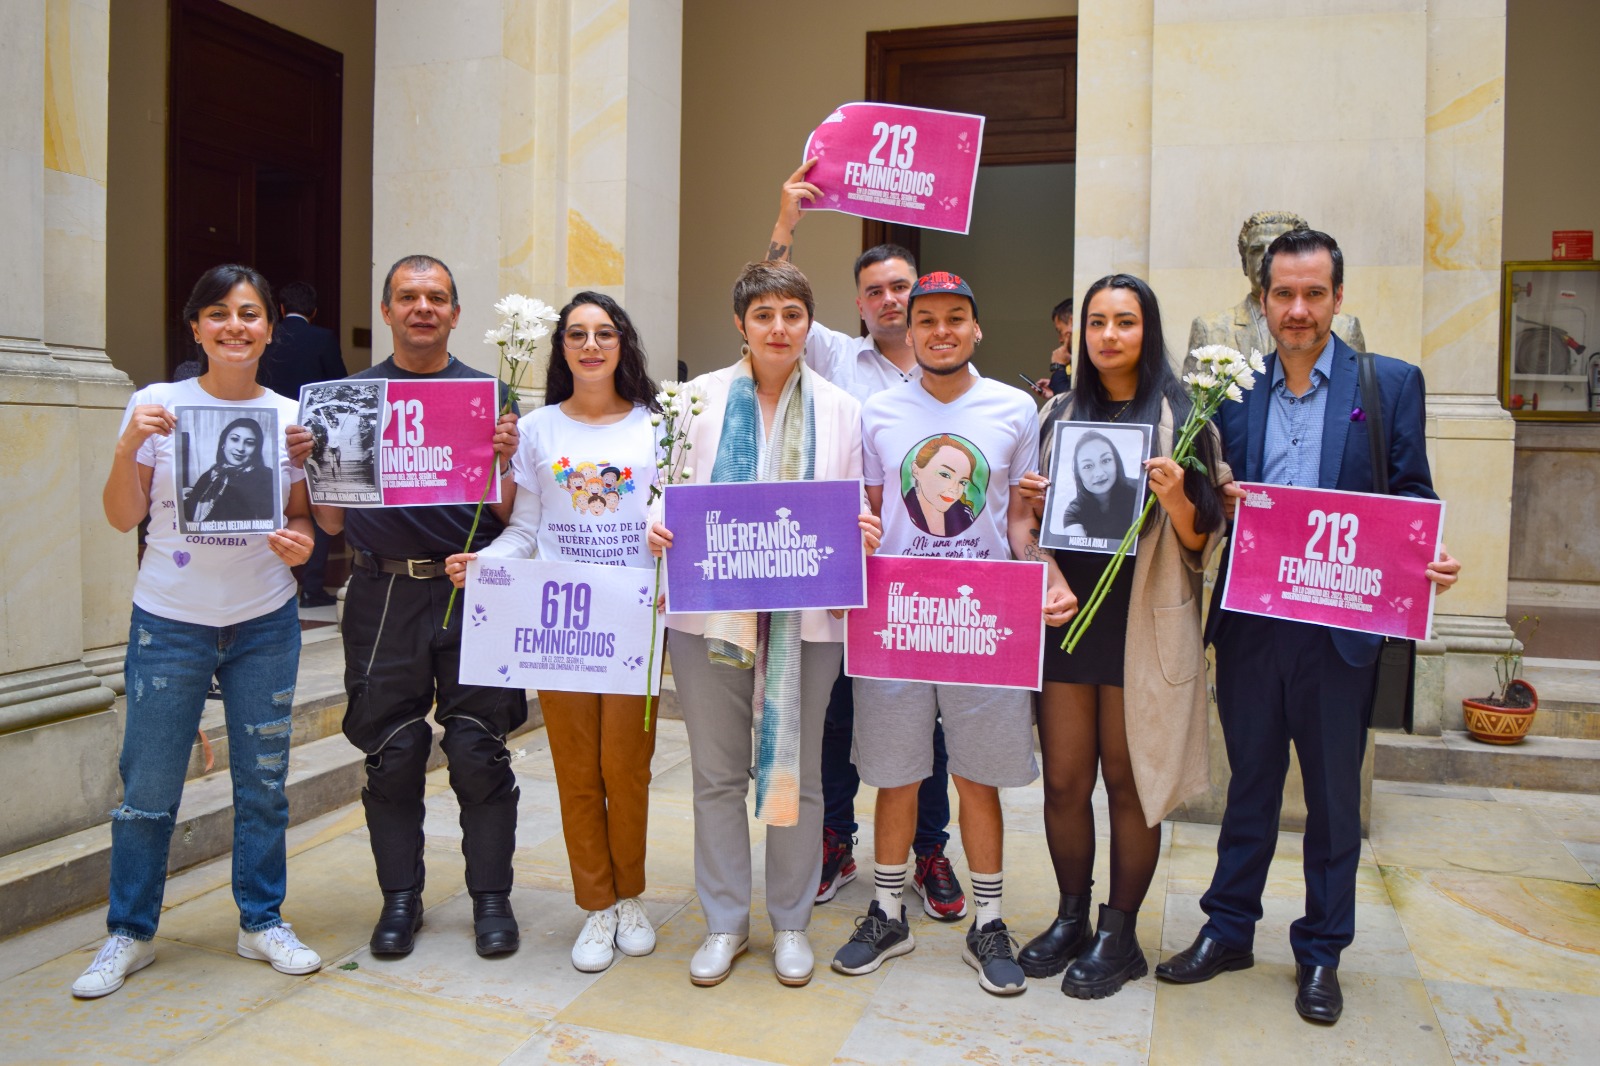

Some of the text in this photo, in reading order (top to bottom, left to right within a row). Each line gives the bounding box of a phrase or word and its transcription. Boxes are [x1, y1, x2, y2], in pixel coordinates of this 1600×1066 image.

[868, 122, 917, 170] 213
[844, 162, 935, 197] FEMINICIDIOS
[901, 200, 926, 210] FEMINICIDIOS
[382, 446, 452, 472] INICIDIOS
[421, 479, 447, 487] FEMINICIDIOS
[706, 510, 721, 524] LEY
[200, 520, 227, 531] ANGÉLICA
[252, 520, 274, 530] ARANGO
[548, 523, 576, 532] SOMOS
[596, 524, 617, 532] VOZ
[620, 523, 633, 532] DE
[186, 535, 247, 546] COLOMBIA
[558, 534, 640, 545] HUÉRFANOS POR
[706, 518, 817, 552] HUÉRFANOS POR
[1305, 510, 1358, 564] 213
[912, 536, 980, 550] Ni una menos
[561, 546, 639, 557] FEMINICIDIO EN
[708, 548, 818, 580] FEMINICIDIOS
[1278, 556, 1382, 597] FEMINICIDIOS
[889, 582, 904, 595] LEY
[541, 581, 591, 630] 619
[888, 592, 997, 627] HUÉRFANOS POR
[1345, 601, 1372, 612] FEMINICIDIOS
[515, 628, 615, 657] FEMINICIDIOS
[887, 622, 997, 655] FEMINICIDIOS
[519, 661, 548, 669] OBSERVATORIO
[549, 663, 574, 671] COLOMBIANO
[580, 665, 607, 673] FEMINICIDIOS
[566, 656, 579, 664] SEGÚN
